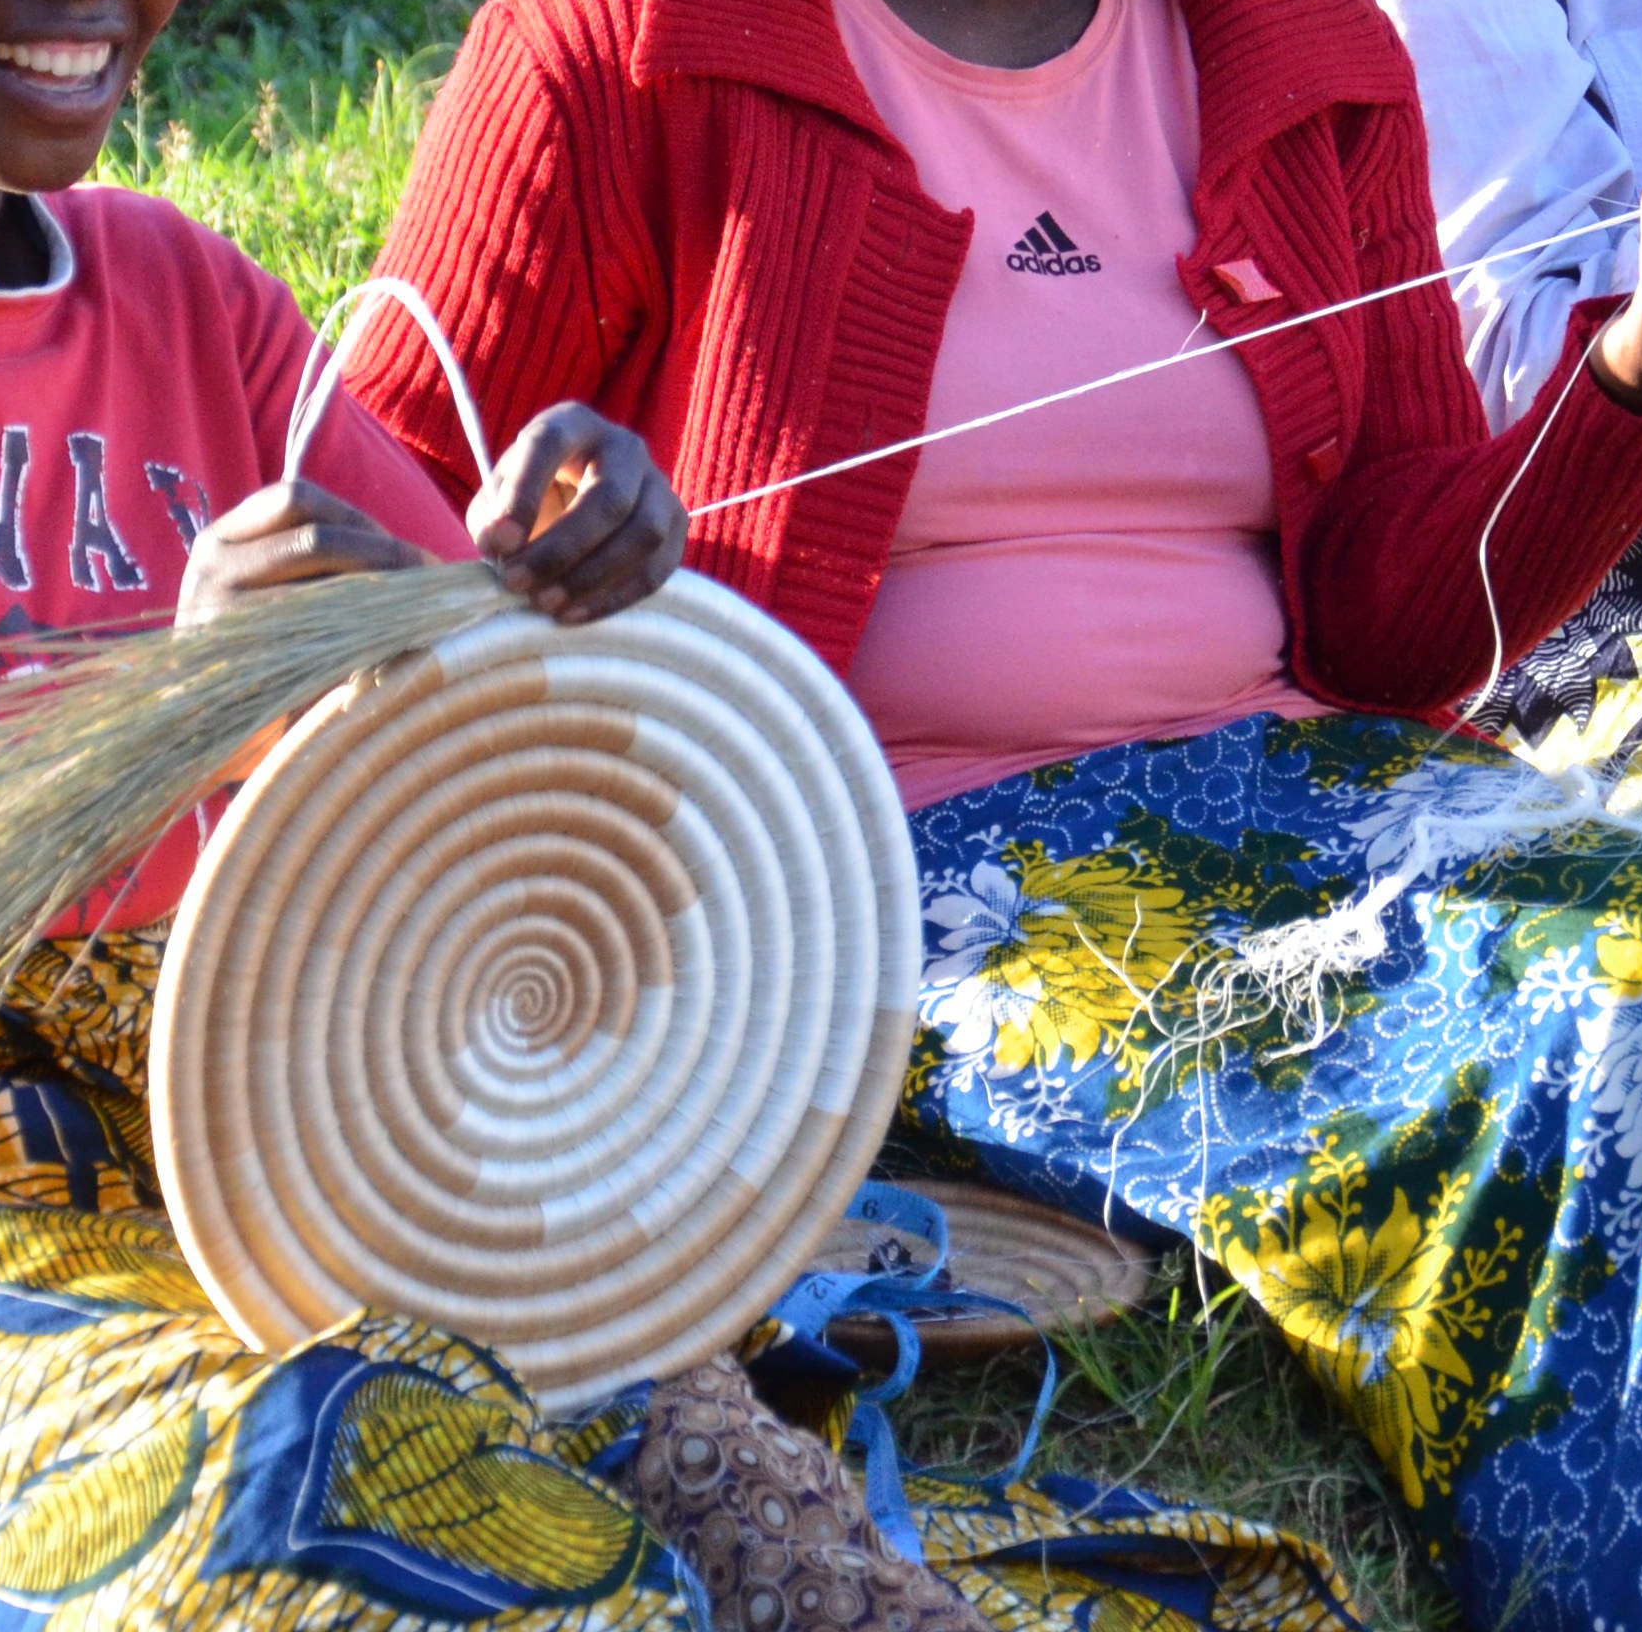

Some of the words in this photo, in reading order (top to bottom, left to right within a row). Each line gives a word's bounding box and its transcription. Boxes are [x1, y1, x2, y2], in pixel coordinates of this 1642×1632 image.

[1006, 251, 1102, 277] adidas
[862, 1199, 878, 1219] 6
[924, 1217, 935, 1238] 7
